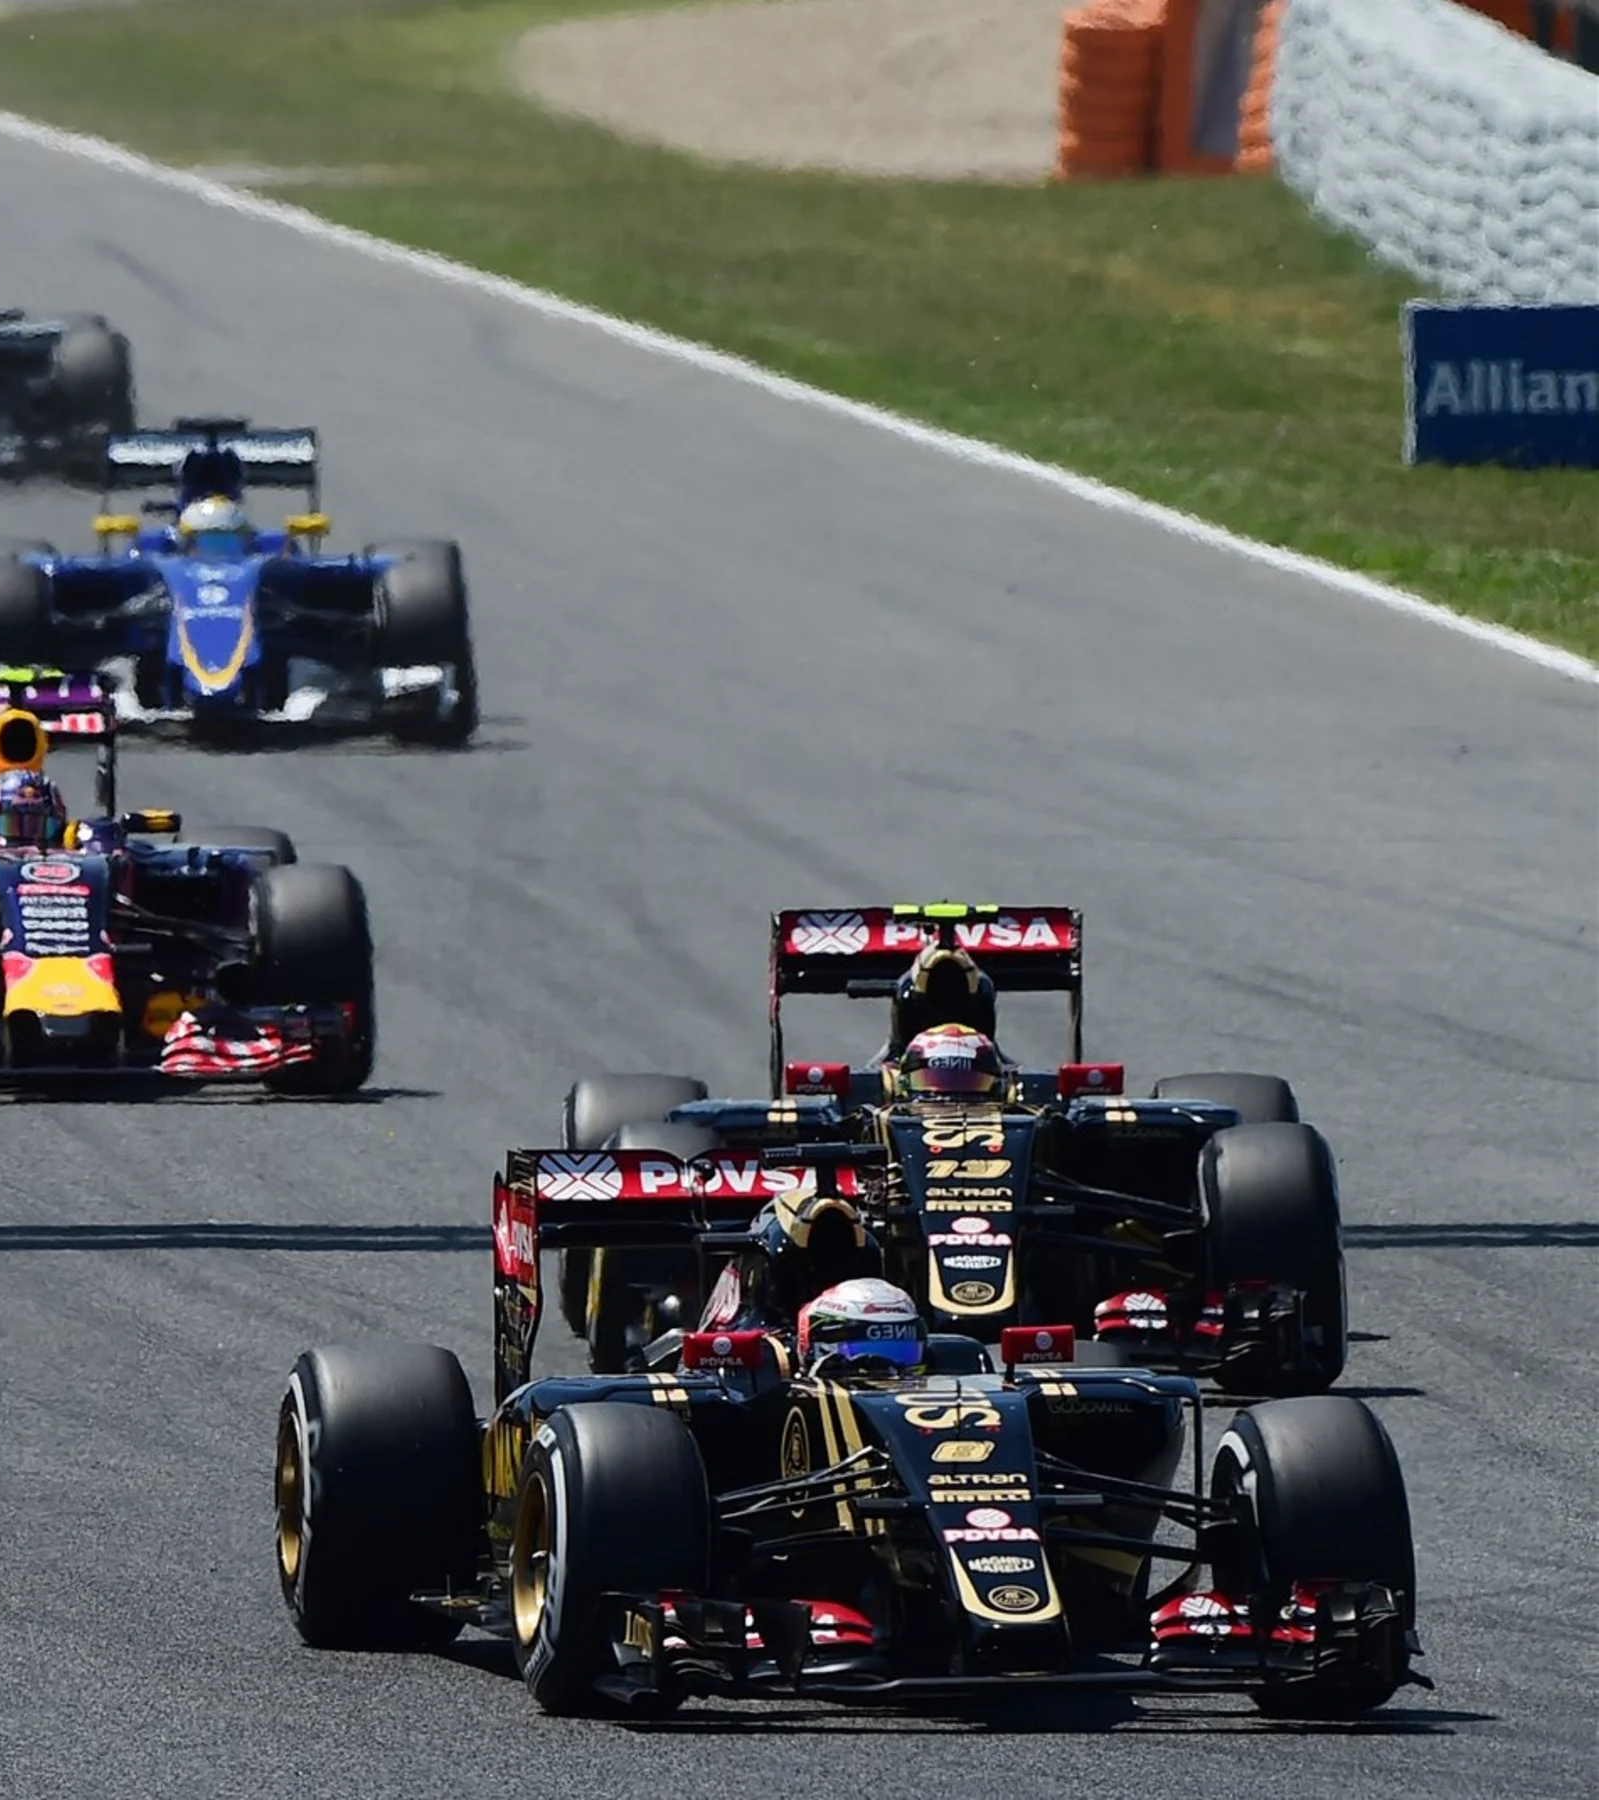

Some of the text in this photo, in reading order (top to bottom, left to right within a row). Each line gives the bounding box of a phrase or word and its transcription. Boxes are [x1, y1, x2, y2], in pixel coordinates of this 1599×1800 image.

[1421, 358, 1599, 416] Allian
[928, 1234, 1013, 1246] PDVSA
[699, 1356, 744, 1367] PDVSA
[1023, 1353, 1062, 1362] PDVSA
[1049, 1401, 1135, 1414] GOODWILL
[930, 1489, 1032, 1502] PIRELLI
[942, 1529, 1041, 1542] PDVSA
